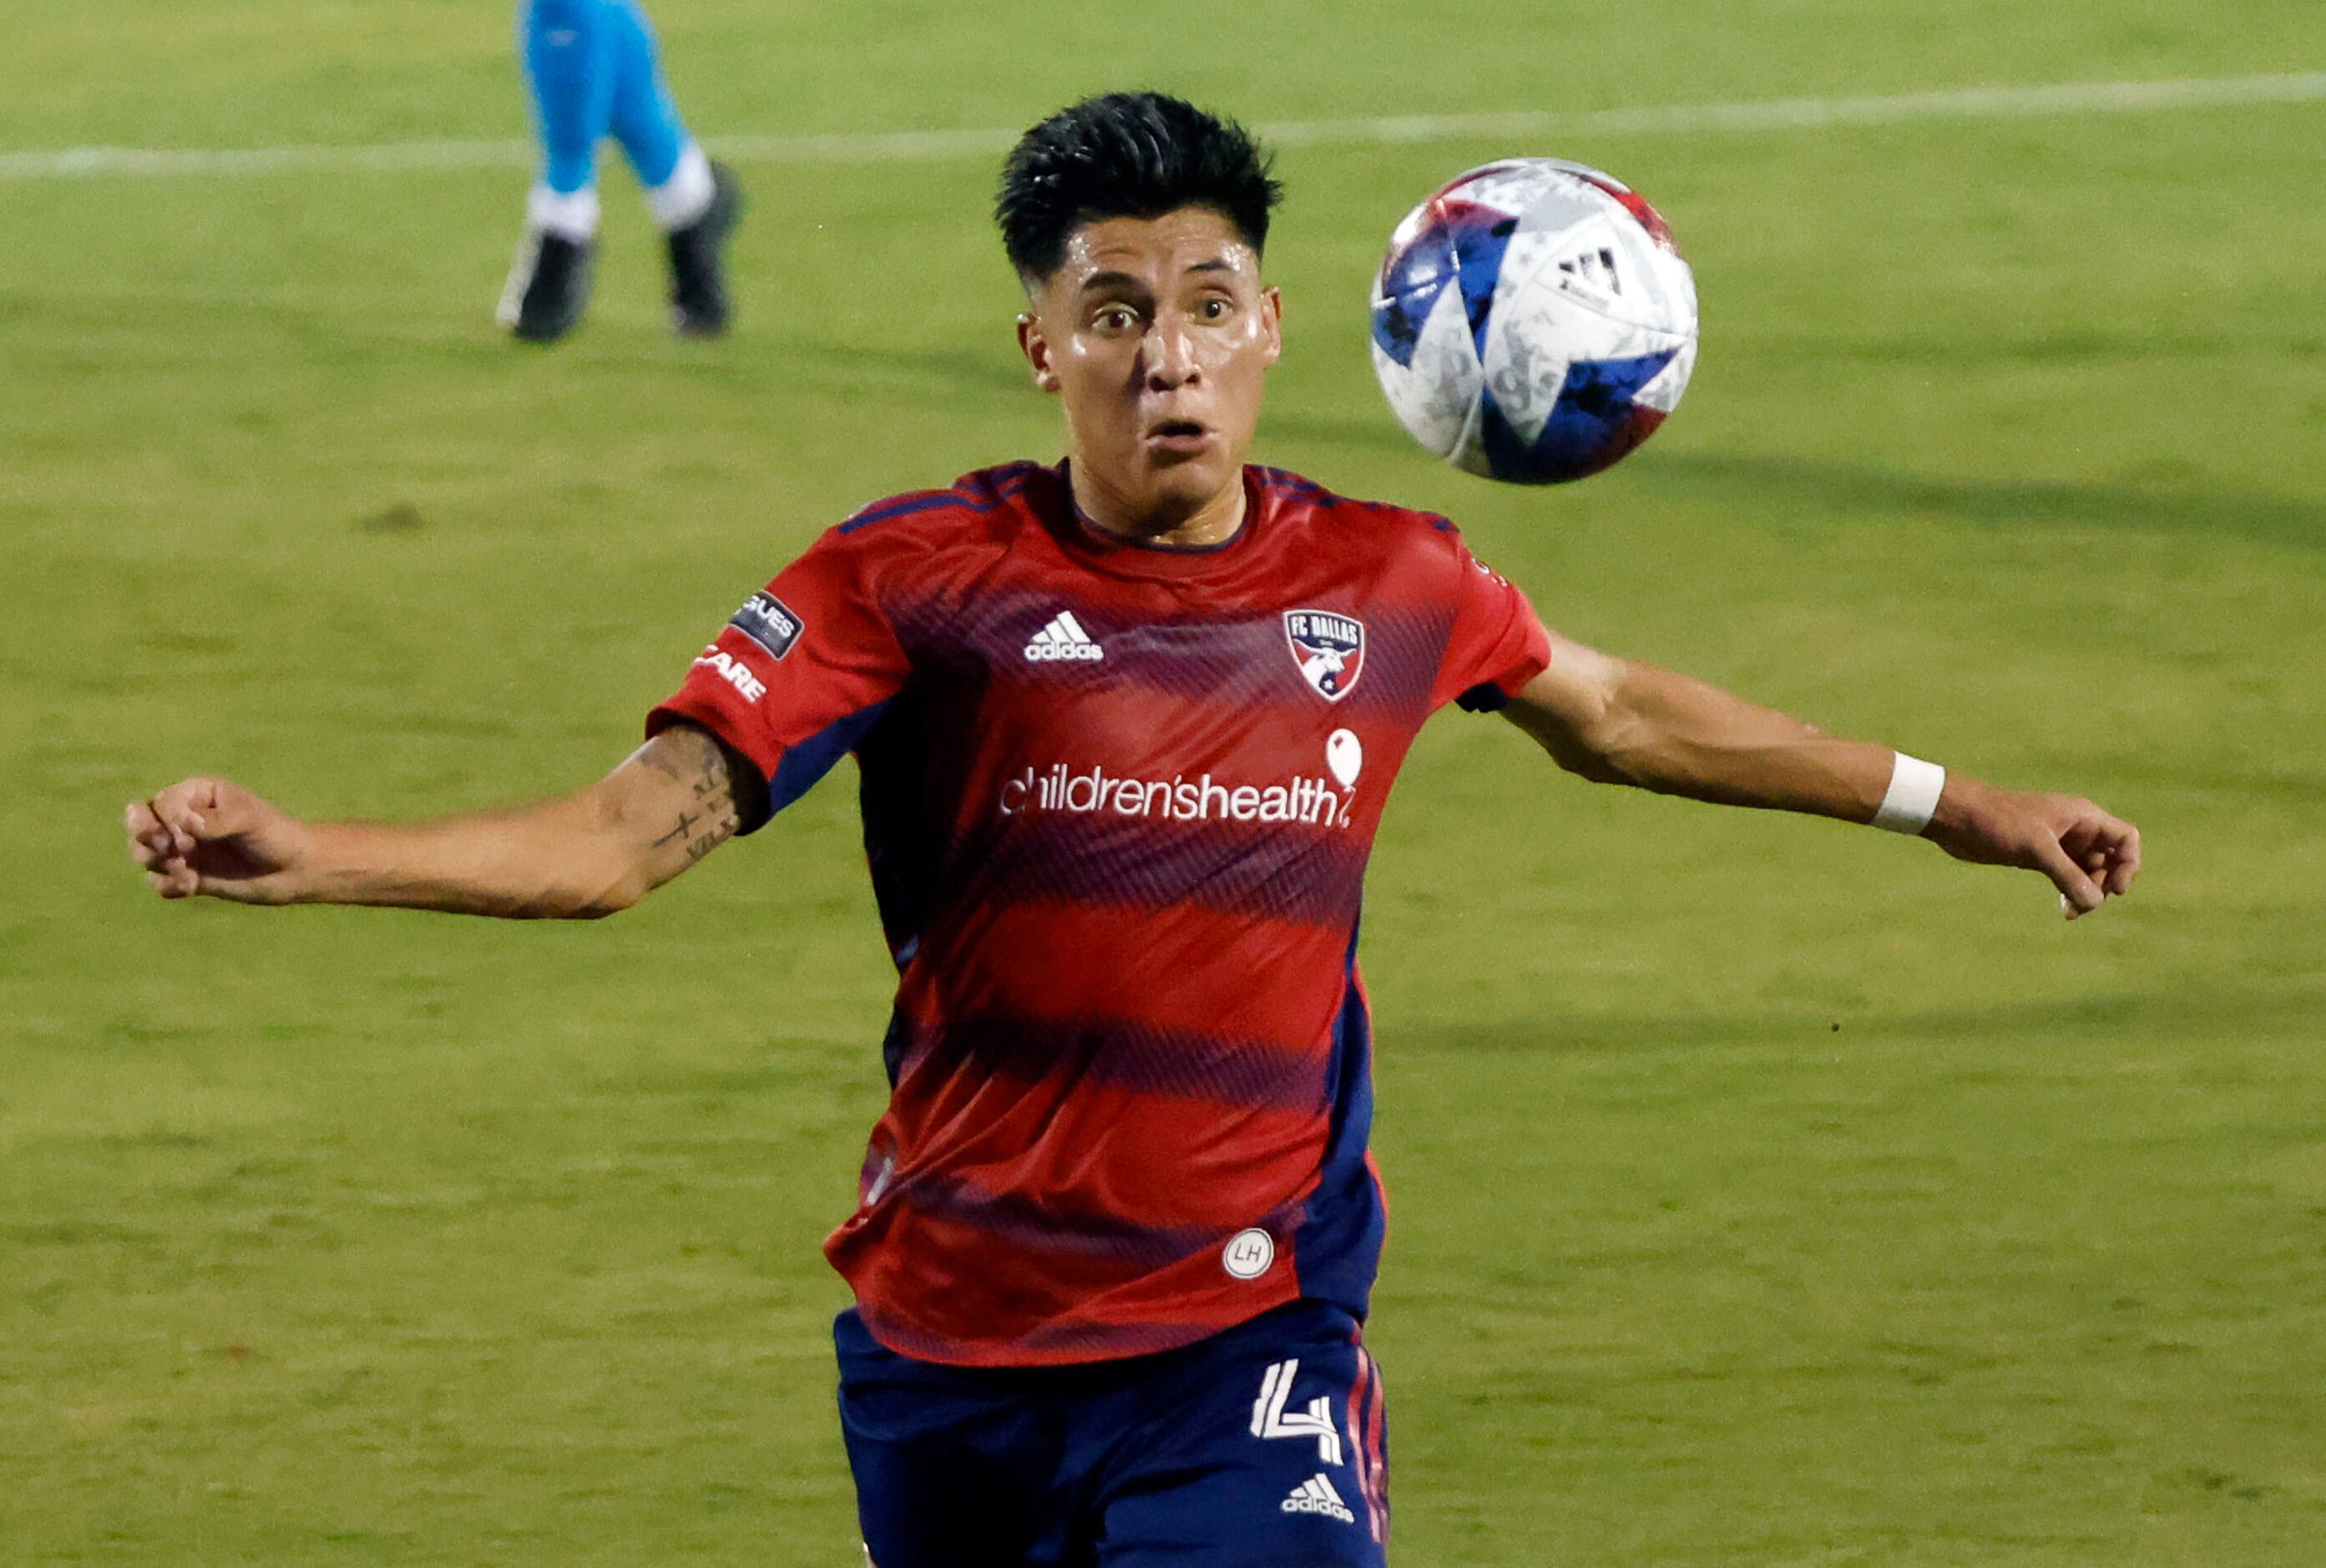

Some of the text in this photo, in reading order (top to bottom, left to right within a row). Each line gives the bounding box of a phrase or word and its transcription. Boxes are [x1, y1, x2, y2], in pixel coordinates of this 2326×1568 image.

[1292, 615, 1358, 645] FC DALLAS
[1024, 640, 1104, 661] adidas
[1234, 1242, 1262, 1263] LH
[1249, 1358, 1343, 1466] 4
[1282, 1496, 1355, 1524] adidas
